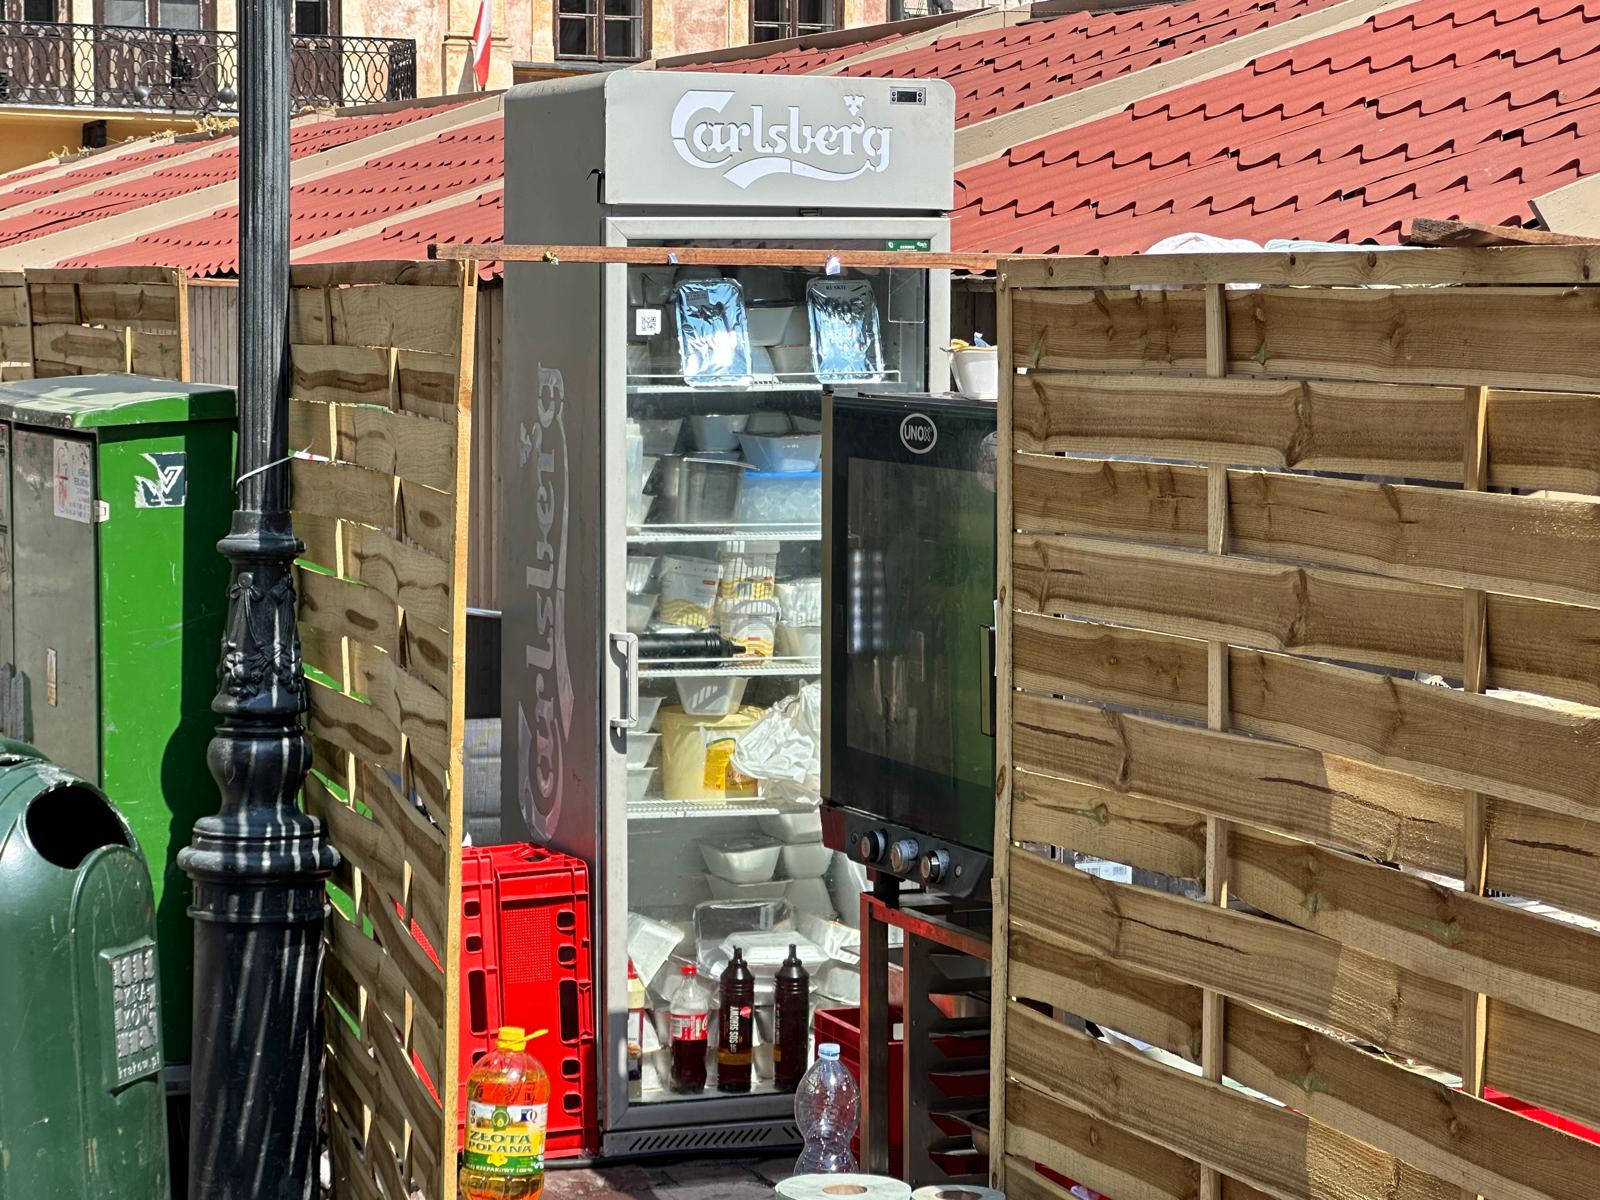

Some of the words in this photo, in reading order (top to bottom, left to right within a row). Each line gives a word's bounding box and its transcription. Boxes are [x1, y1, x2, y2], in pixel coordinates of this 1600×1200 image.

[670, 90, 893, 173] Carlsberg
[903, 424, 933, 443] UNOX
[518, 361, 566, 843] Carlsberg
[468, 1140, 531, 1153] POLANA
